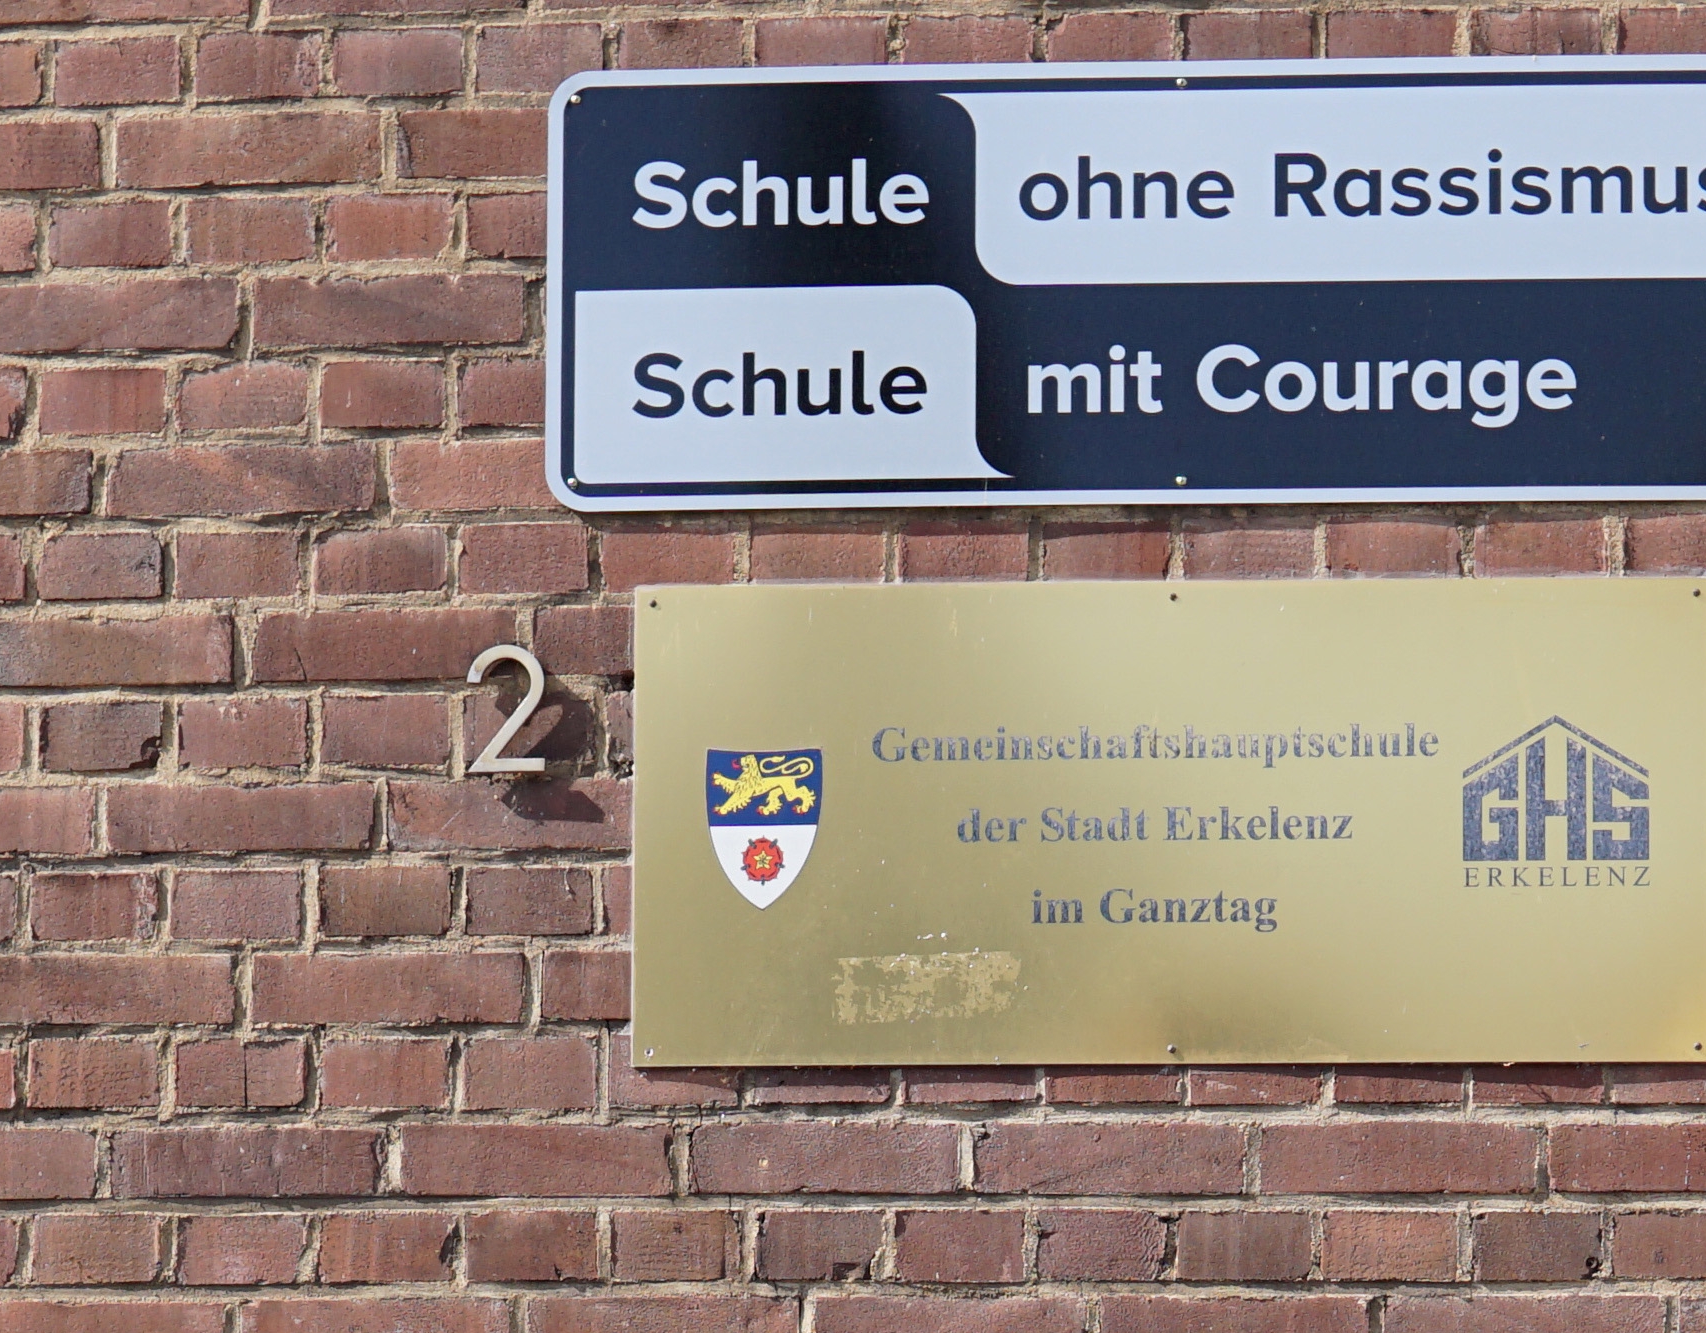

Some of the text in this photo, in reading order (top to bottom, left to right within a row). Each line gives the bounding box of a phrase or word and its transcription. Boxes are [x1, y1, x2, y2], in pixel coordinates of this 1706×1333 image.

[632, 158, 930, 230] Schule
[1019, 155, 1235, 222] ohne
[632, 343, 1578, 427] Schule mit Courage
[467, 644, 545, 772] 2
[871, 722, 1439, 771] Gemeinschaftshauptschule
[957, 804, 1354, 844] der Stadt Erkelenz
[1462, 726, 1649, 861] GHS
[1462, 867, 1650, 887] ERKELENZ
[1031, 887, 1278, 934] im Ganztag
